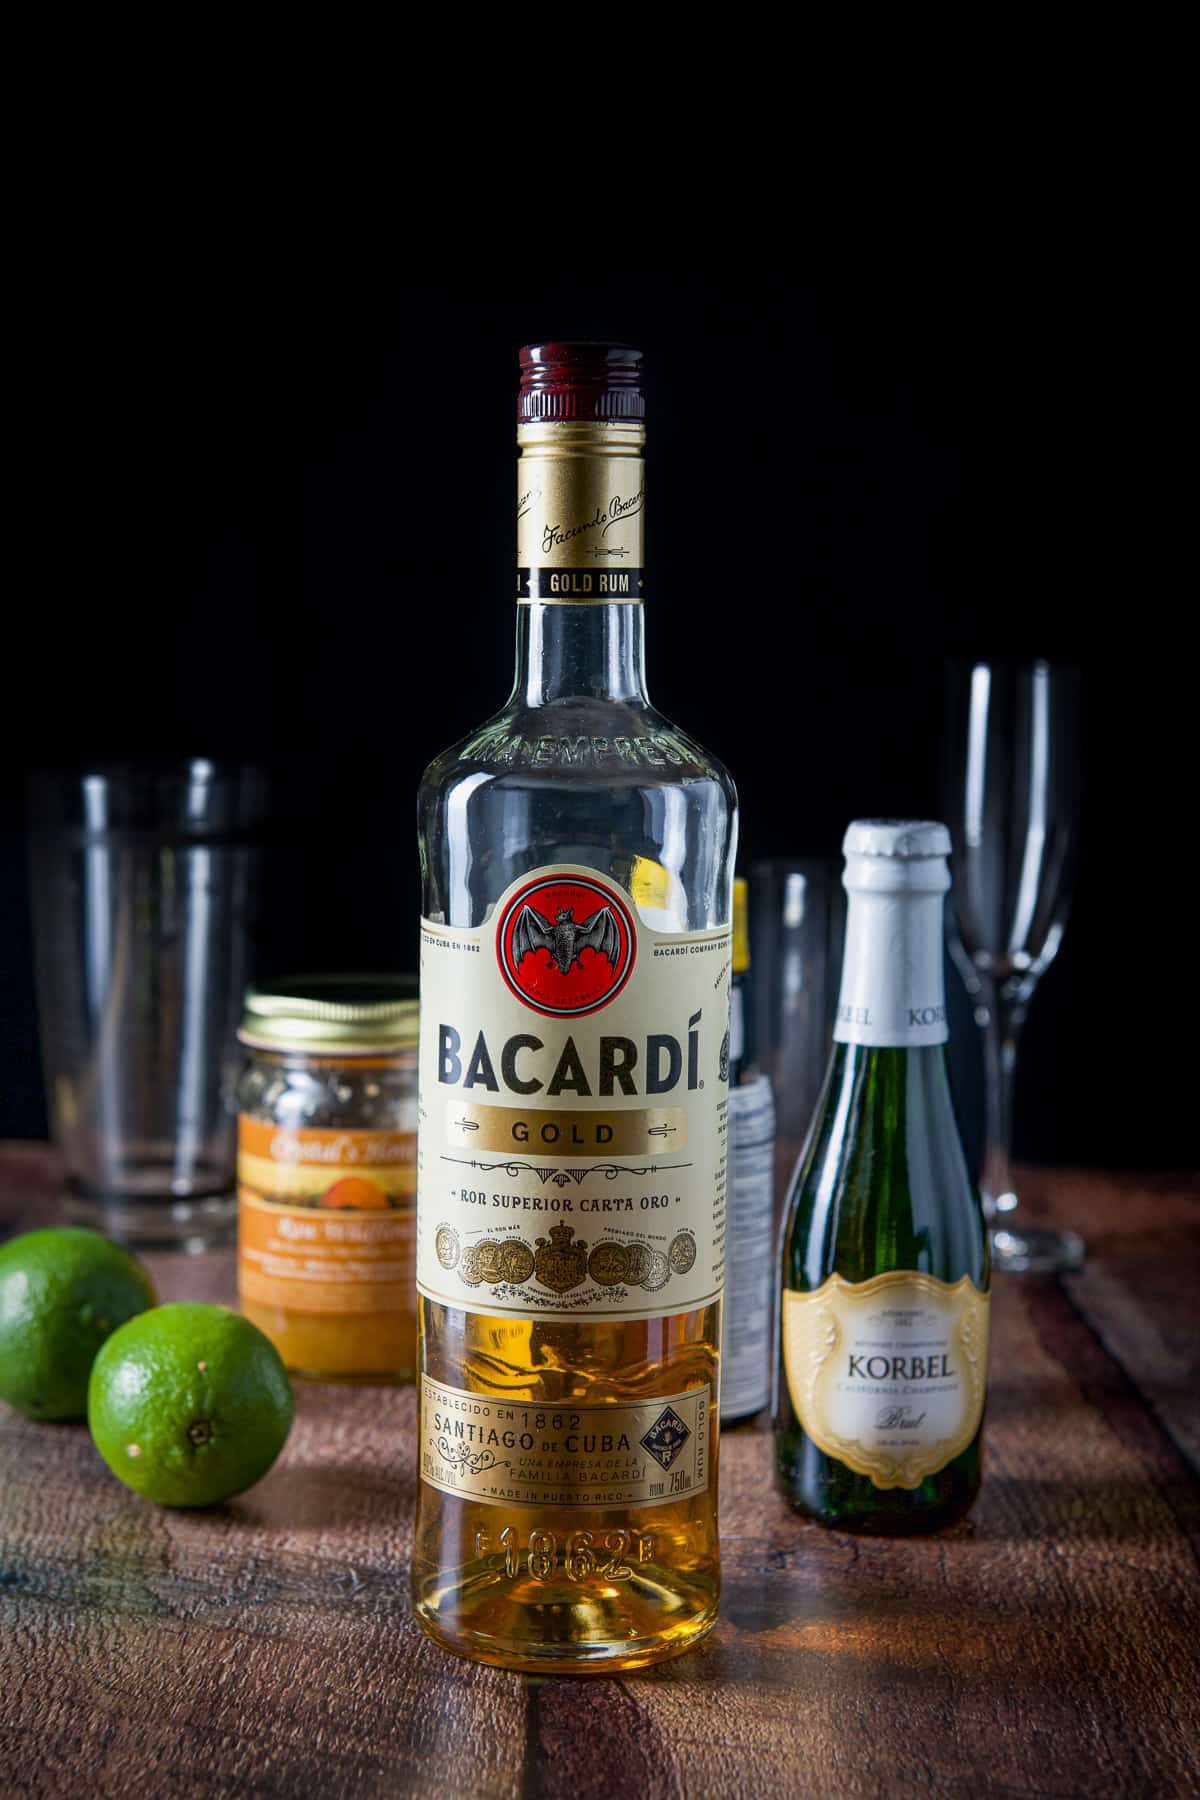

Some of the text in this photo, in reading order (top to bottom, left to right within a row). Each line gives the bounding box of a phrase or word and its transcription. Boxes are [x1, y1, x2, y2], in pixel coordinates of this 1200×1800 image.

[542, 508, 607, 553] Facundo
[551, 574, 629, 592] GOLD RUM
[690, 943, 717, 955] COMPANY
[437, 1008, 703, 1097] BACARDÍ
[511, 1121, 615, 1145] GOLD
[461, 1189, 670, 1213] RON SUPERIOR CARTA ORO
[848, 1354, 955, 1380] KORBEL
[424, 1386, 581, 1431] ESTABLECIDO EN 1862
[874, 1405, 927, 1430] Brut
[434, 1412, 534, 1450] SANTIAGO
[542, 1441, 560, 1452] DE
[565, 1432, 631, 1453] CUBA
[520, 1458, 639, 1469] UNA EMPRESA DE LA
[662, 1450, 672, 1462] R
[510, 1464, 647, 1482] FAMILIA BACARDÍ
[491, 1487, 623, 1501] MADE IN PUERTO RICO
[500, 1527, 634, 1583] 1862
